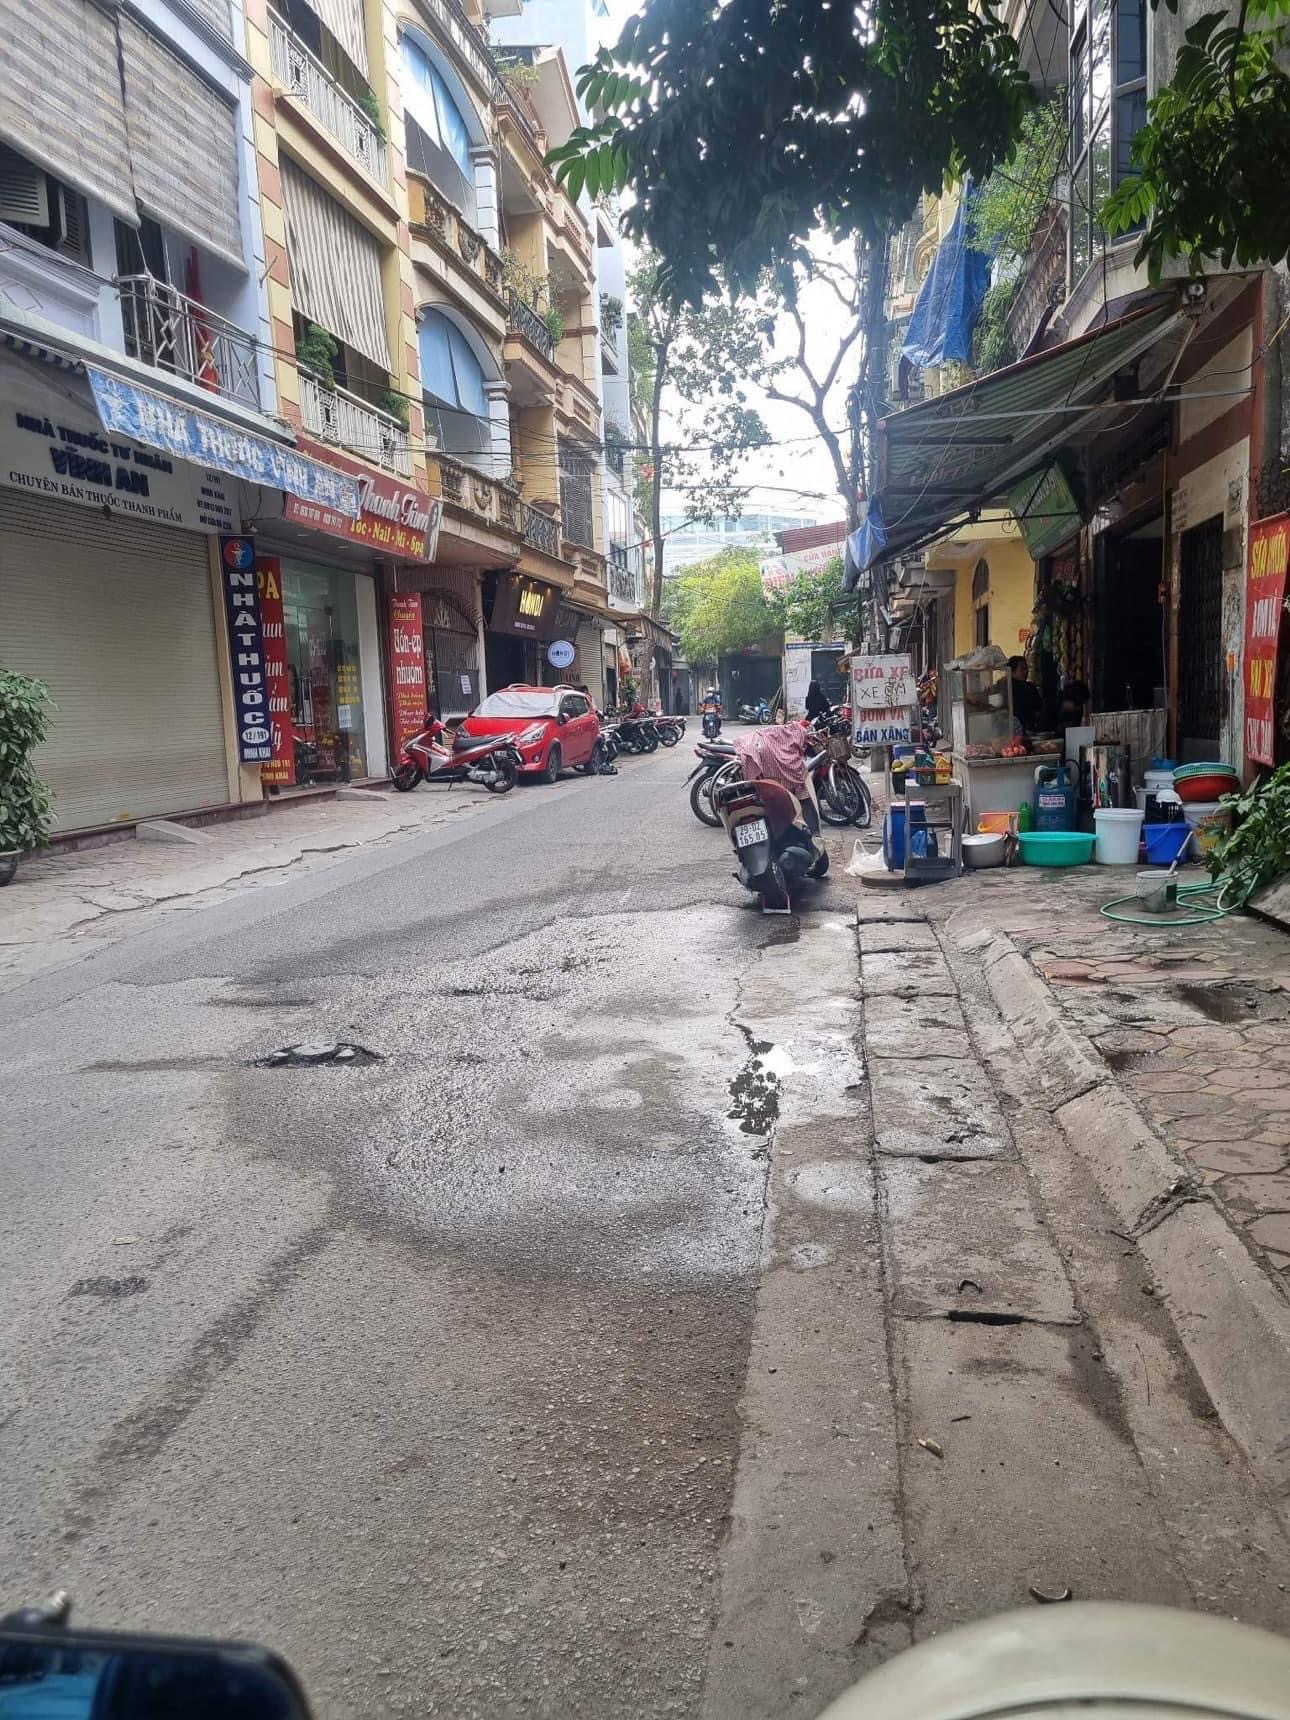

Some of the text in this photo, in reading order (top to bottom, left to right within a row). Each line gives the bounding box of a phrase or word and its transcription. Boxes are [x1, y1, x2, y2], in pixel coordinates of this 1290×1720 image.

[16, 412, 56, 438] NHÀ
[9, 471, 183, 522] CHUYÊN BÁN THUỐC THANH PHẨM
[357, 473, 400, 522] Thanh
[373, 521, 391, 543] Nail
[411, 535, 424, 556] Spa
[393, 626, 421, 658] Uốn-ép
[396, 660, 423, 689] nhuộm
[860, 686, 879, 699] XE
[856, 725, 909, 743] BÁN XĂNG
